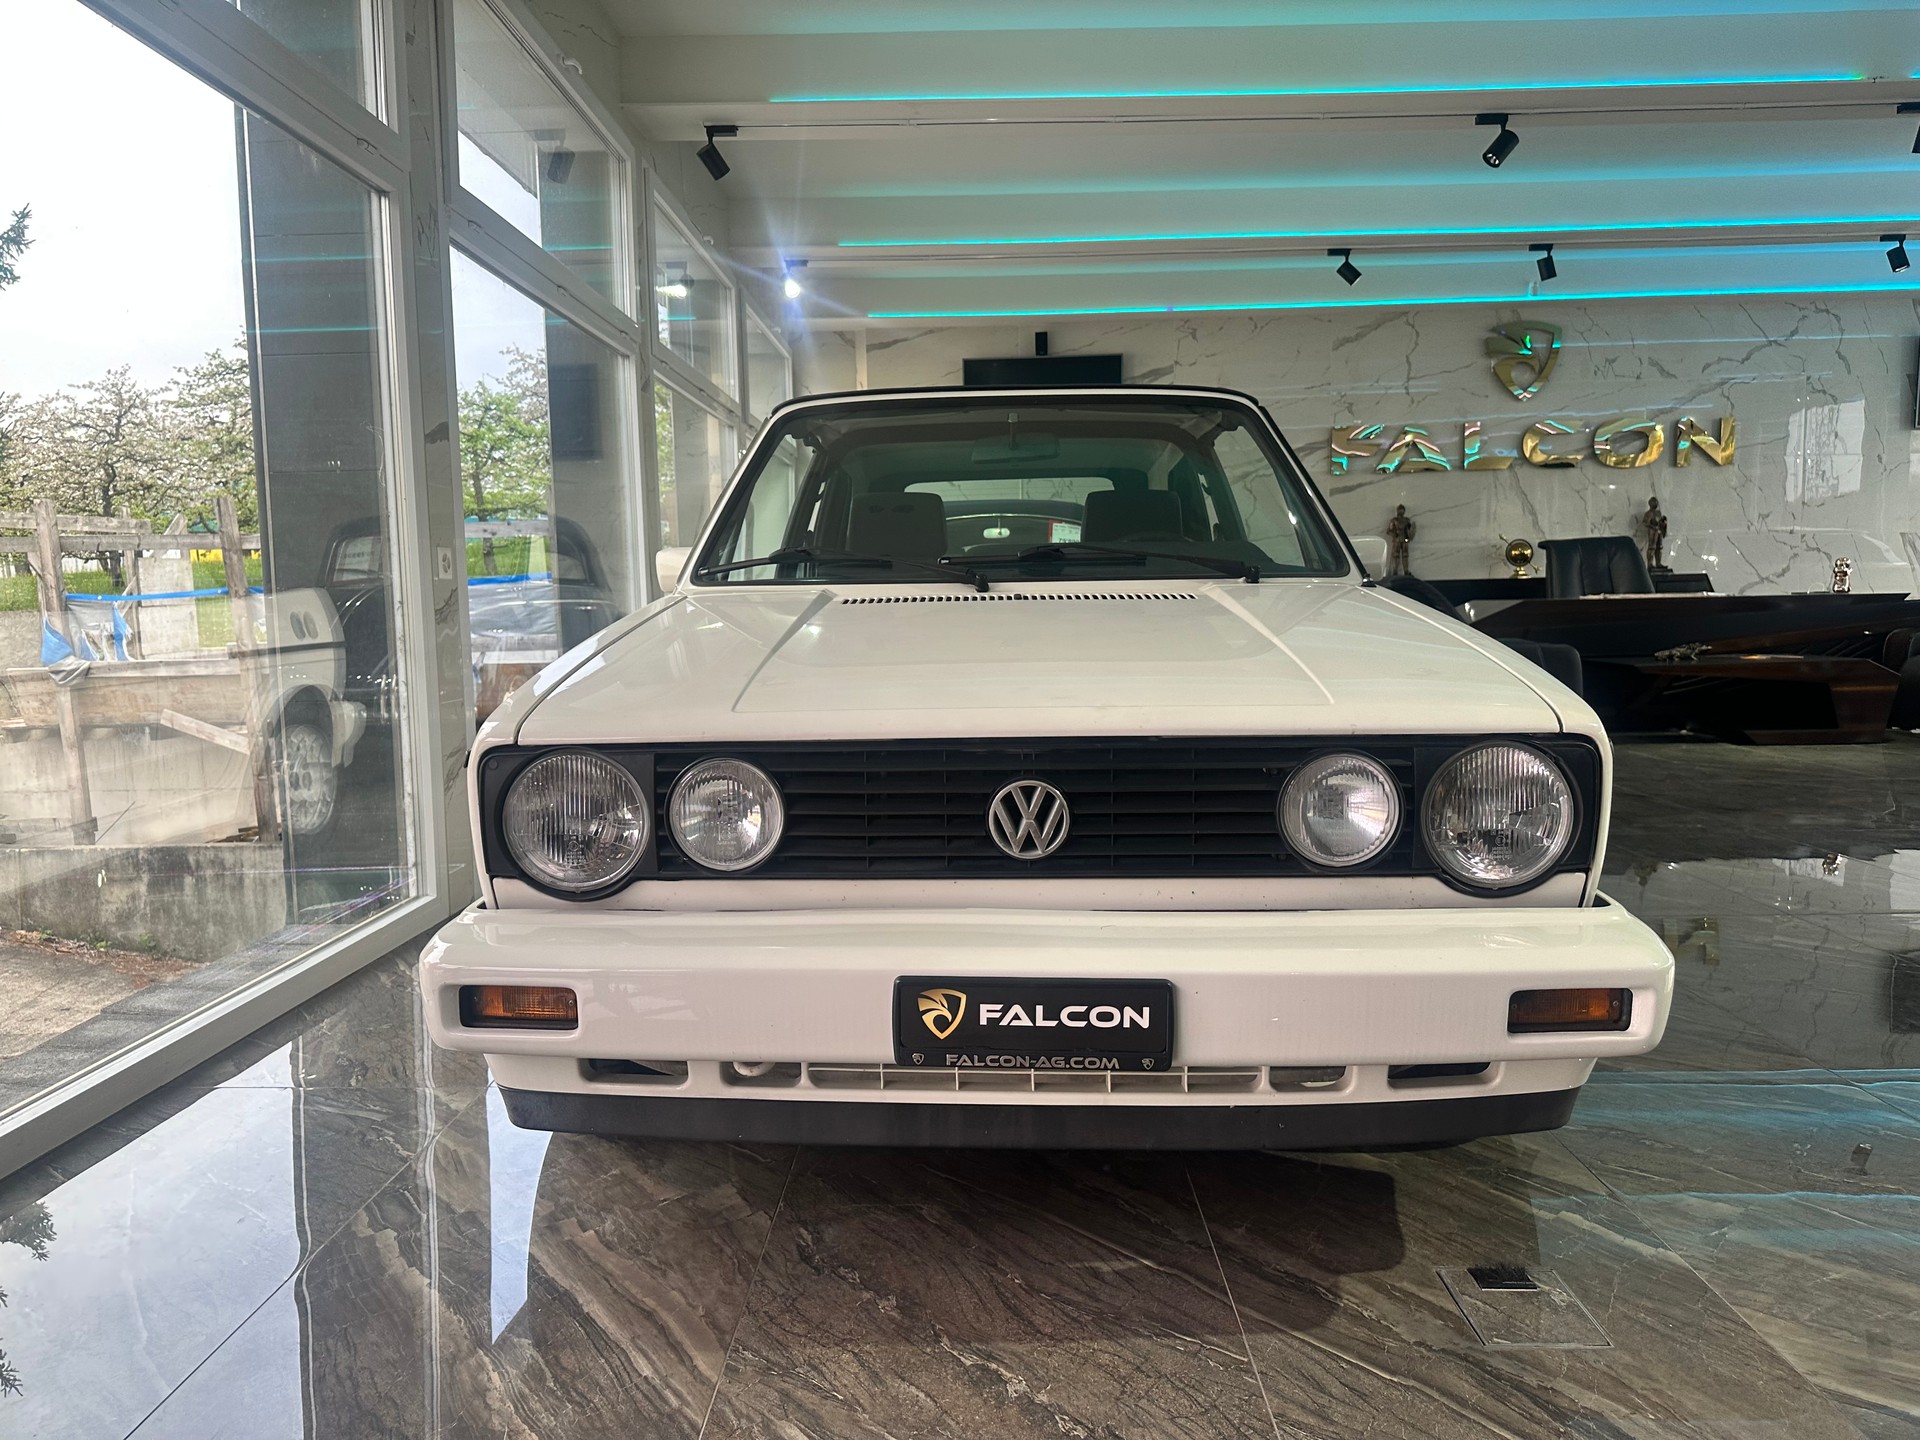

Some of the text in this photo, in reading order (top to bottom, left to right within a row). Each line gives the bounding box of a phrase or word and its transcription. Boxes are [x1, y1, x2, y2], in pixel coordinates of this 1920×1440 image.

[1330, 417, 1735, 475] FALCON
[988, 780, 1070, 859] VW
[979, 1003, 1150, 1029] FALCON
[946, 1054, 1120, 1070] FALCON-AG.COM
